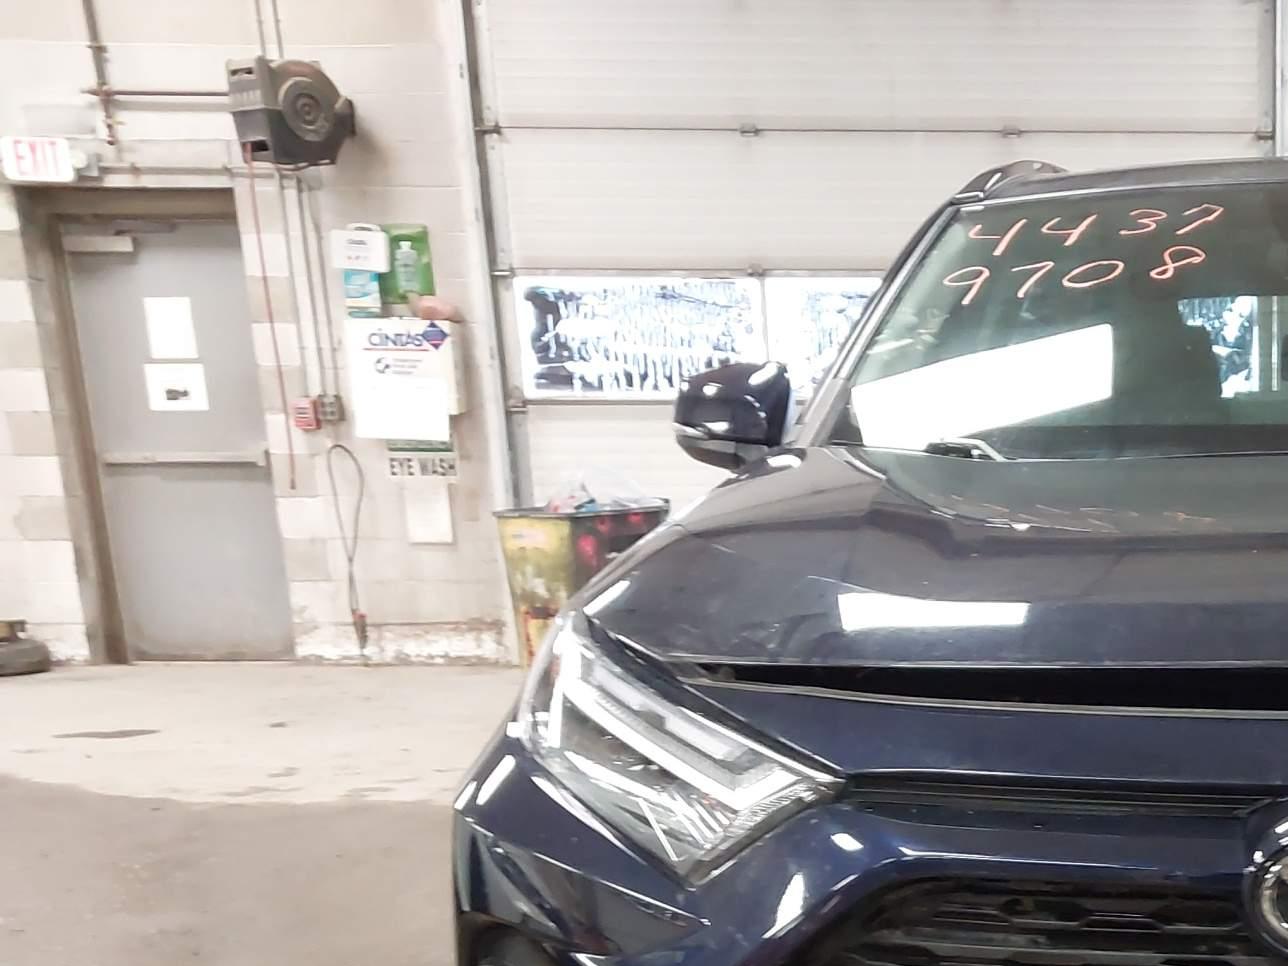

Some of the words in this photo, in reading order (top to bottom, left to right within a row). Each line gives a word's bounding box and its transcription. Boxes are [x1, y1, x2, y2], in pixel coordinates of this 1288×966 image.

[14, 139, 61, 177] EXIT
[967, 203, 1225, 256] 4437
[942, 245, 1207, 305] 9708
[368, 330, 423, 347] CINTAS
[389, 457, 415, 476] EYE
[418, 457, 458, 476] WASH
